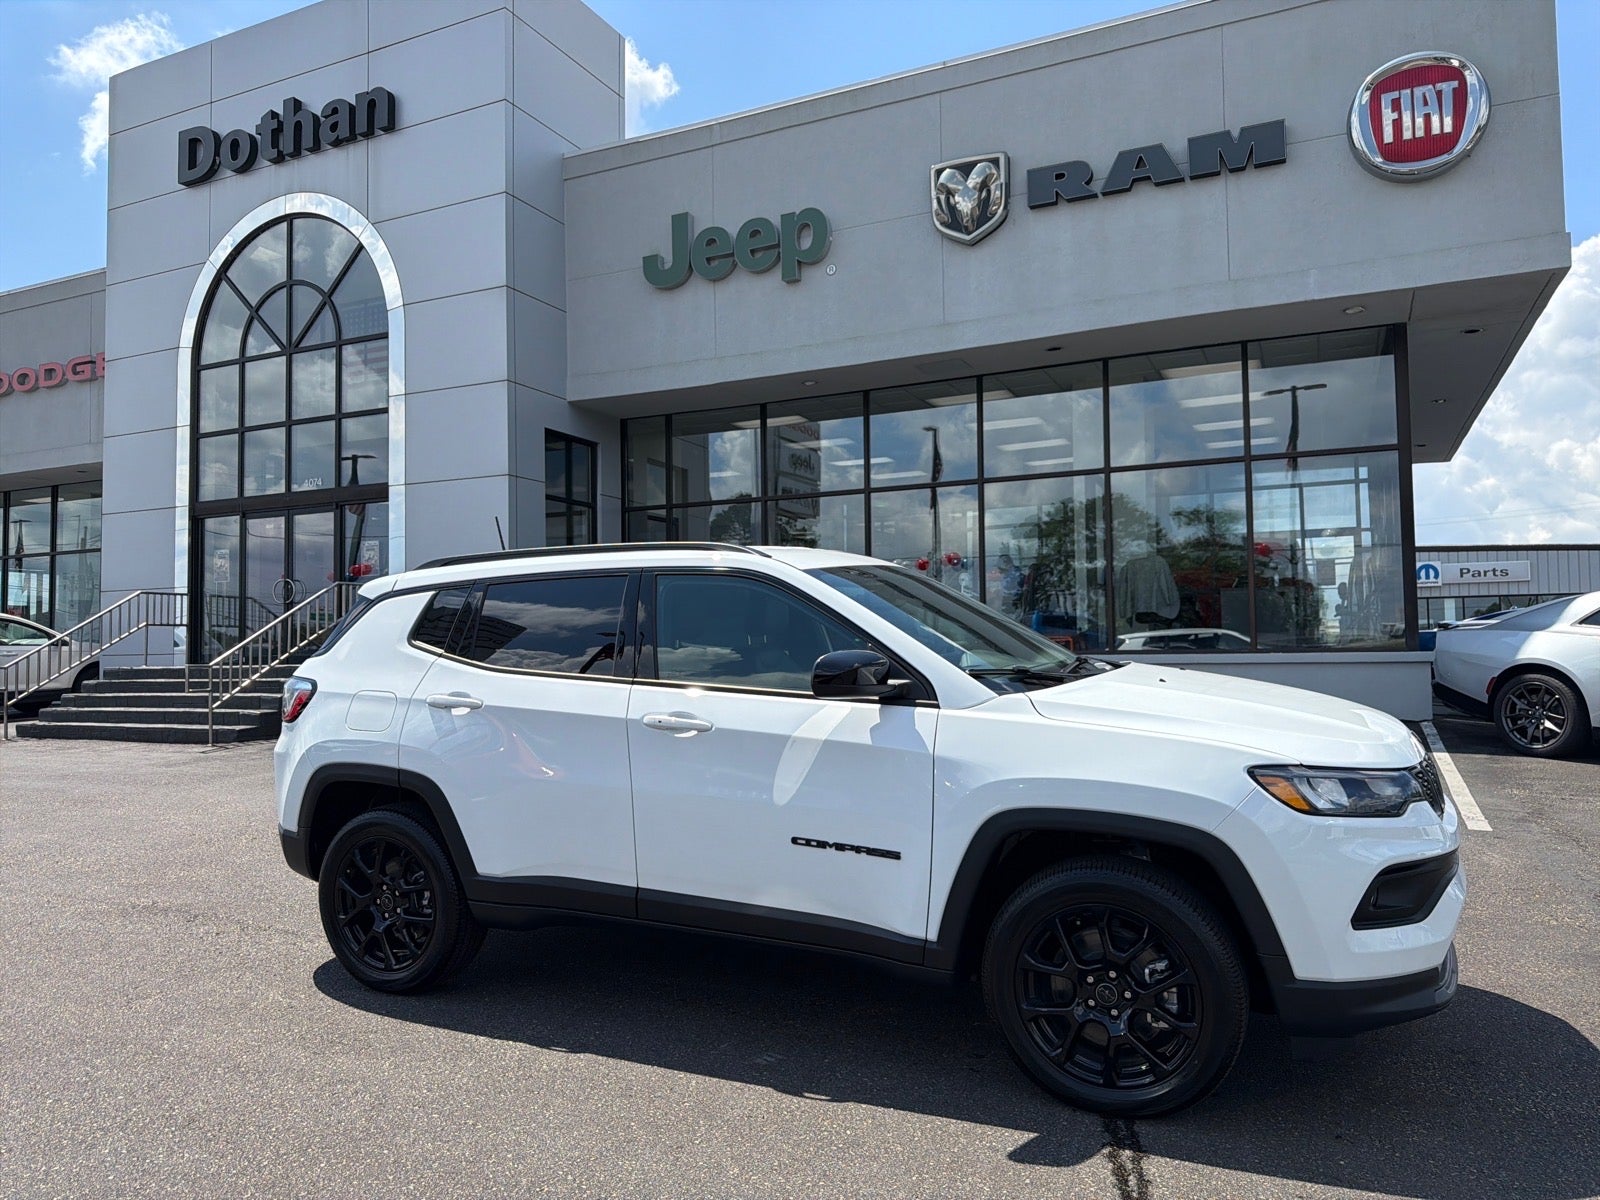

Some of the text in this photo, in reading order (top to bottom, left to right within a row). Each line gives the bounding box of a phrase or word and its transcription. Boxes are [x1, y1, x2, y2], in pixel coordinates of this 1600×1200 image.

[178, 86, 396, 187] Dothan
[1381, 80, 1459, 145] FIAT
[1027, 118, 1287, 210] RAM
[642, 207, 832, 290] Jeep
[303, 477, 322, 488] 4074
[1459, 567, 1509, 579] Parts
[791, 836, 902, 860] COMPASS
